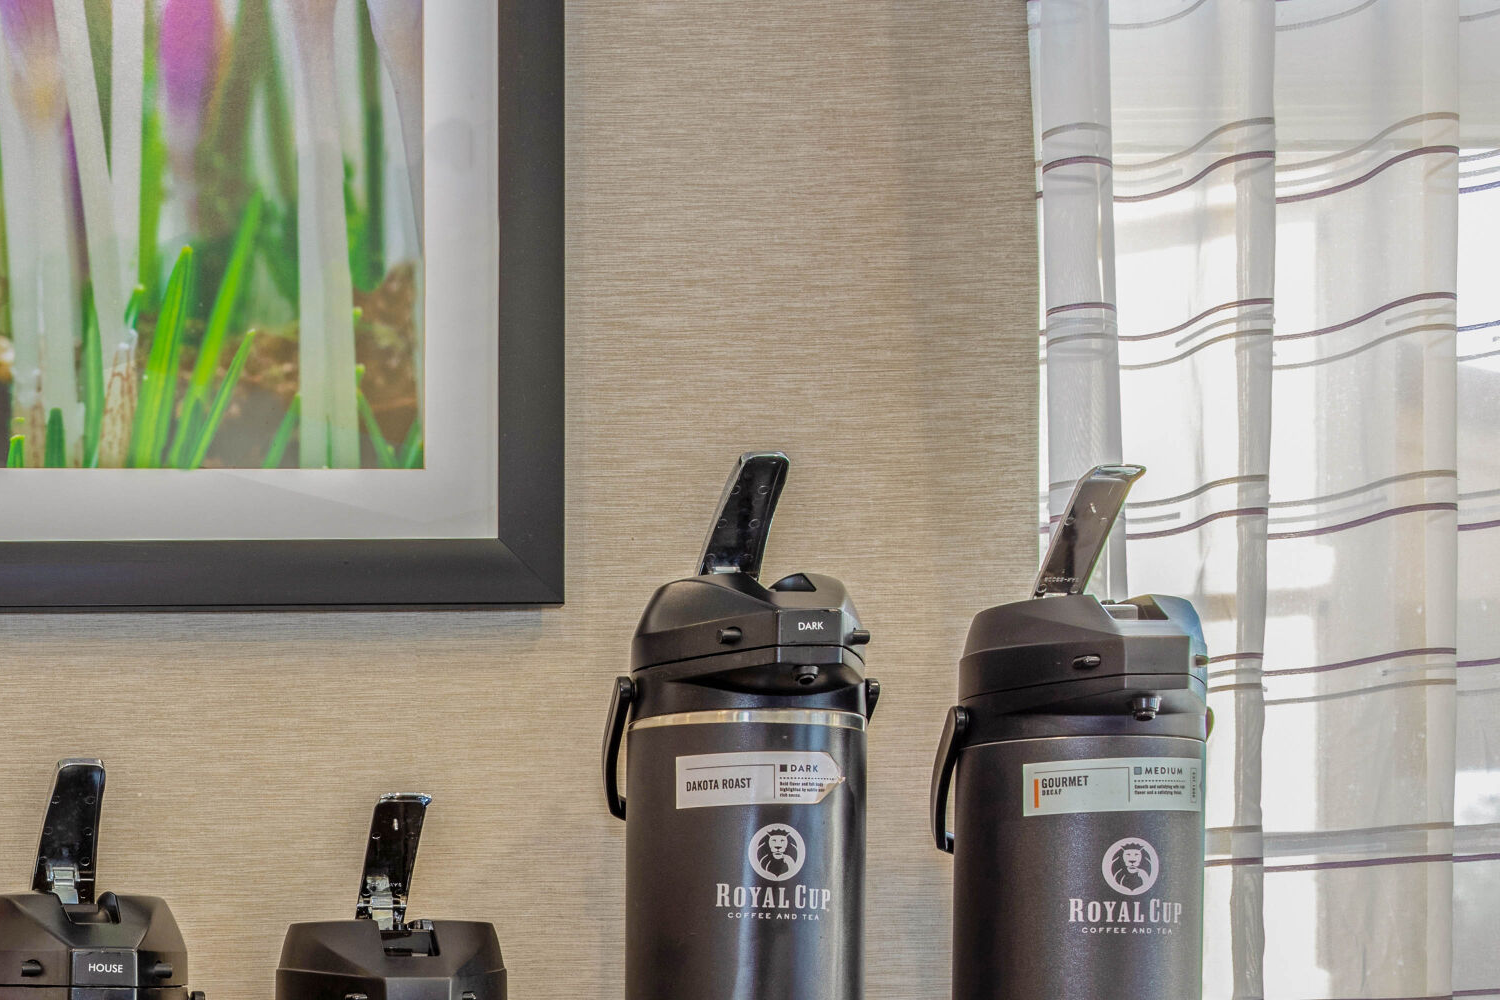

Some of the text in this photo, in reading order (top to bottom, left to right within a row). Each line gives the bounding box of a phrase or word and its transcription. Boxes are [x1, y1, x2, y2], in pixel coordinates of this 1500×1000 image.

[797, 621, 825, 631] DARK
[790, 764, 819, 773] DARK
[1144, 766, 1183, 775] MEDIUM
[686, 777, 752, 792] DAKOTA ROAST
[1041, 775, 1089, 789] GOURMET
[1041, 788, 1062, 796] DECAF
[715, 883, 831, 910] ROYAL CUP
[1068, 898, 1182, 924] ROYAL CUP
[88, 963, 124, 974] HOUSE
